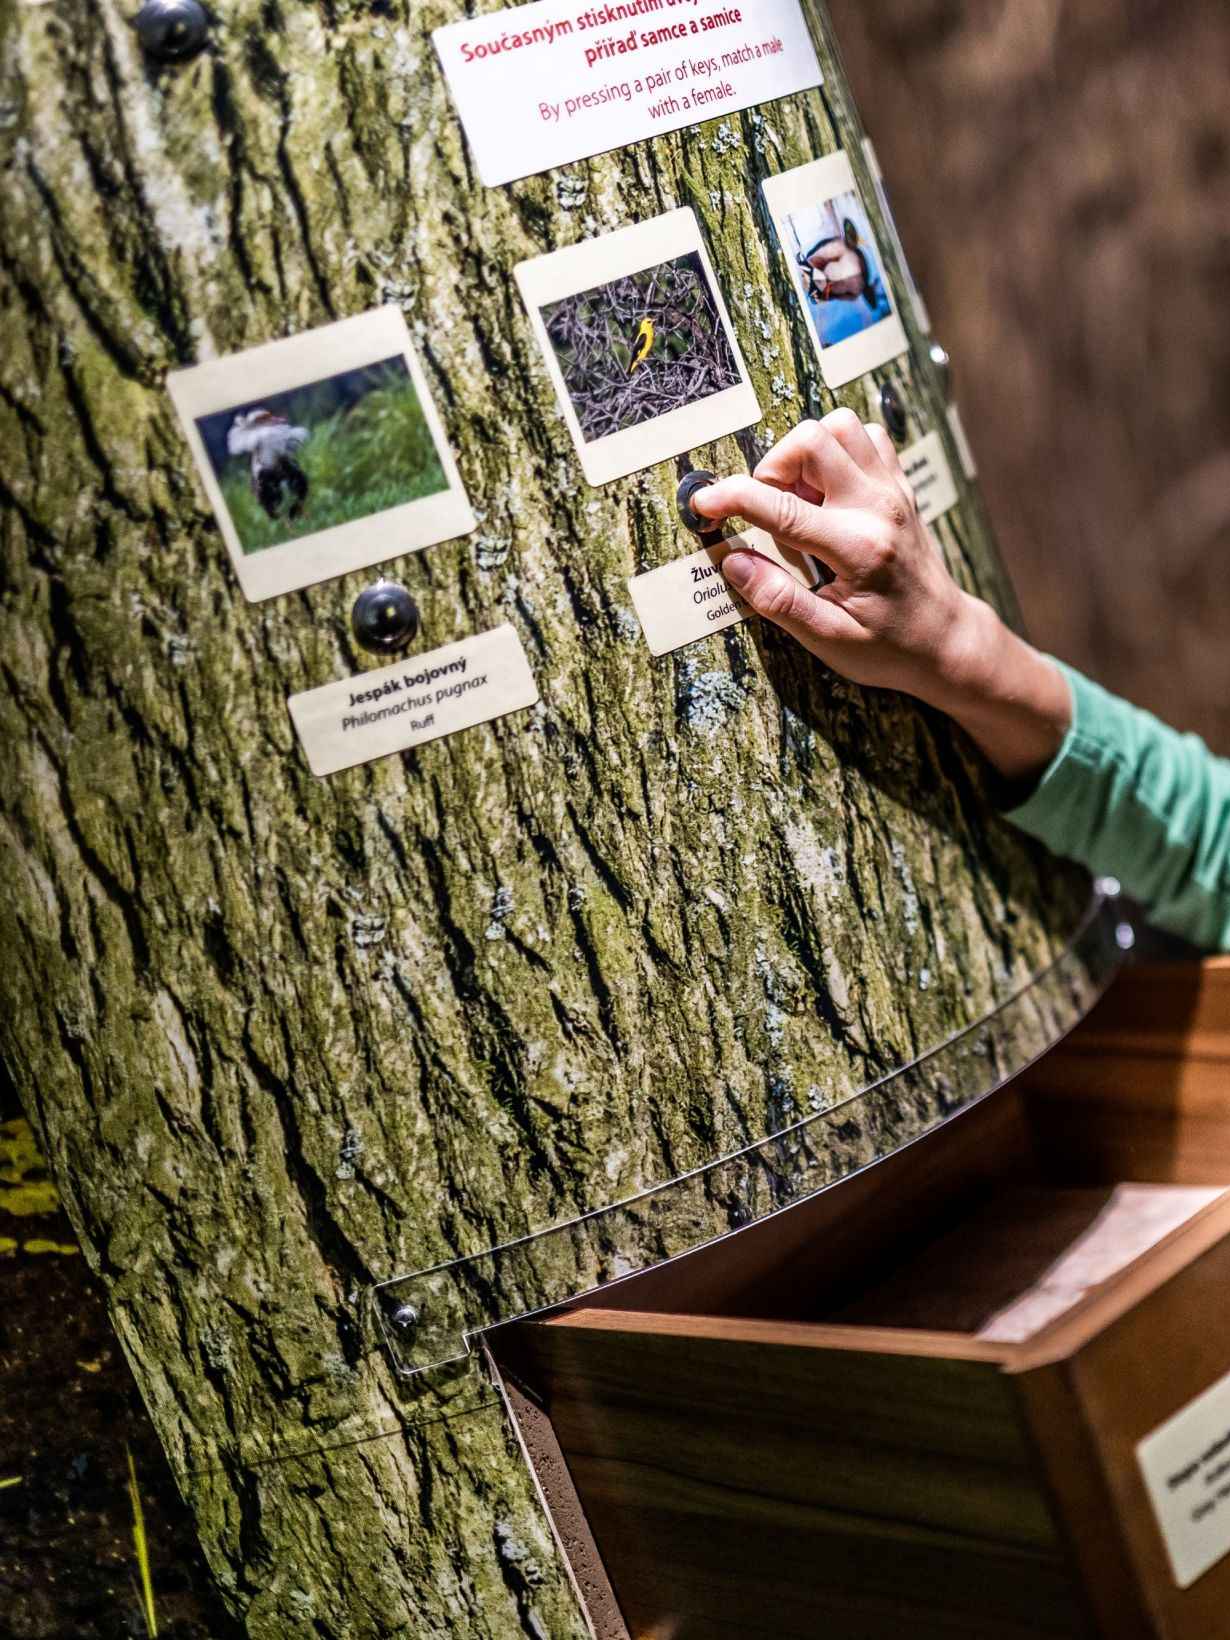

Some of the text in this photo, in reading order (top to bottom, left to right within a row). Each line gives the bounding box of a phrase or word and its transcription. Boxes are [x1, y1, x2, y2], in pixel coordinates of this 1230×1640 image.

[460, 19, 574, 62] Současným
[584, 7, 742, 67] přiřaď samce a samice
[538, 102, 560, 122] By
[565, 82, 632, 116] pressing
[635, 79, 643, 92] a
[646, 68, 671, 94] pair
[675, 60, 688, 80] of
[689, 57, 721, 77] keys,
[721, 43, 755, 68] match
[755, 45, 761, 58] a
[648, 80, 737, 119] with a female.
[691, 564, 722, 583] Žluv
[342, 675, 488, 731] Philomachus pugnax
[349, 656, 467, 707] Jespák bojovný
[410, 713, 434, 731] Ruff
